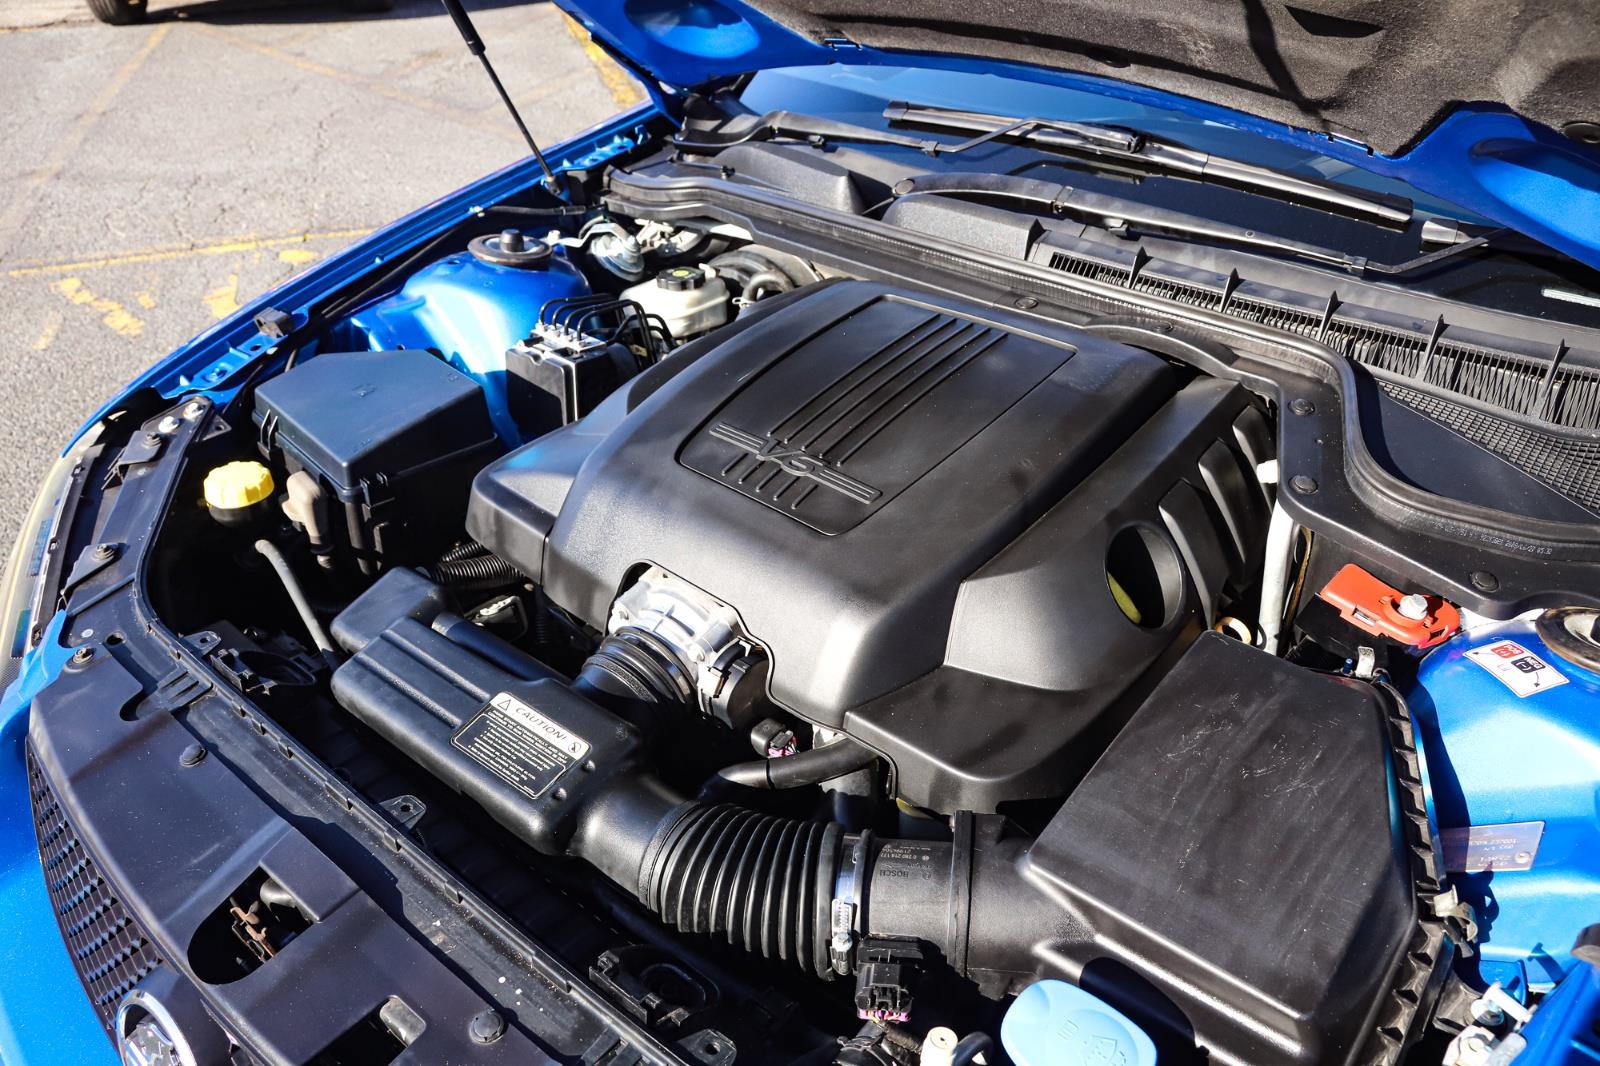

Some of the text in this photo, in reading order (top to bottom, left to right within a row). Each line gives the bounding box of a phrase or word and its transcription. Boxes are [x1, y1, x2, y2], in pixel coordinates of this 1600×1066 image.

[1525, 657, 1541, 669] NEG
[515, 706, 567, 742] CAUTION!
[880, 869, 909, 878] BOSCH
